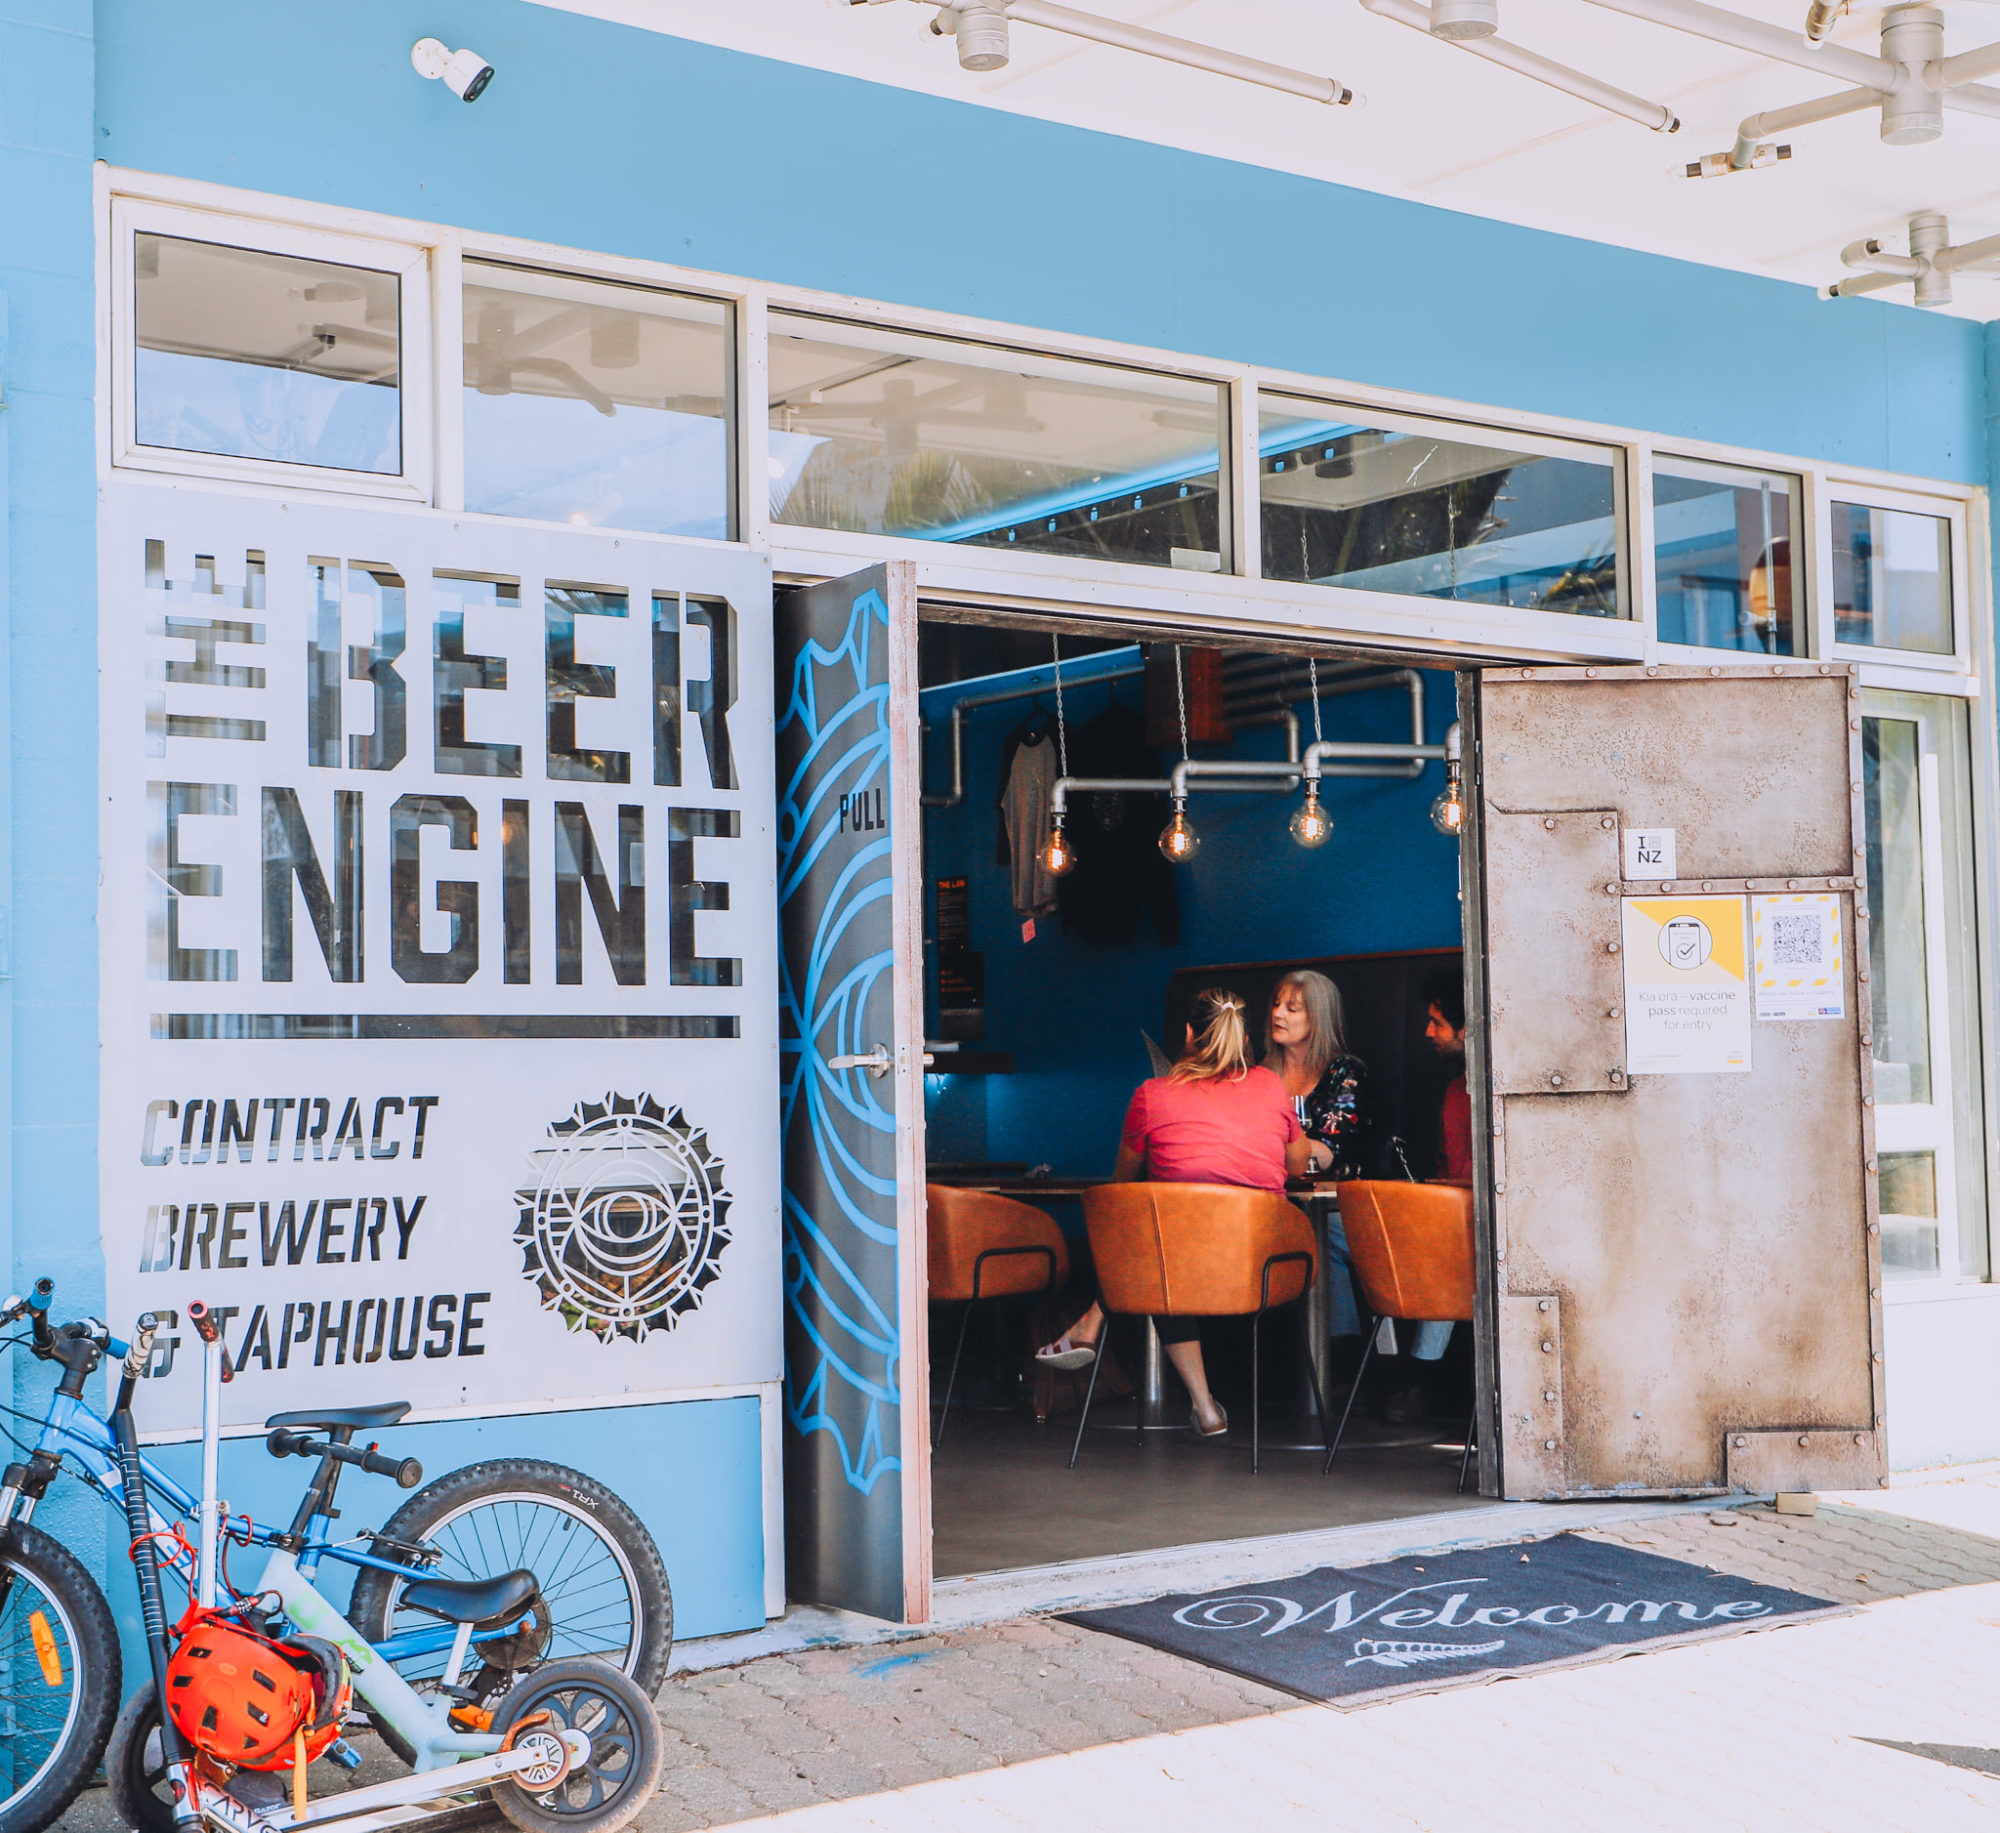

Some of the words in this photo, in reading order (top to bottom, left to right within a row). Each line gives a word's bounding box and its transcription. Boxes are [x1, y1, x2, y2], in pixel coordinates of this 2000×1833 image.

[145, 538, 266, 759] THE
[307, 555, 740, 790] BEER
[840, 788, 885, 834] PULL
[1638, 850, 1662, 864] NZ
[146, 781, 743, 987] ENGINE
[1639, 992, 1656, 1002] Kia
[1658, 992, 1678, 1001] ora
[1689, 990, 1736, 1001] vaccine
[1648, 1007, 1677, 1018] pass
[1679, 1004, 1728, 1017] required
[1664, 1019, 1679, 1030] for
[1681, 1020, 1713, 1031] entry
[140, 1096, 439, 1167] CONTRACT
[140, 1196, 427, 1273] BREWERY
[572, 1489, 600, 1510] XR1
[1172, 1577, 1773, 1637] Welcome
